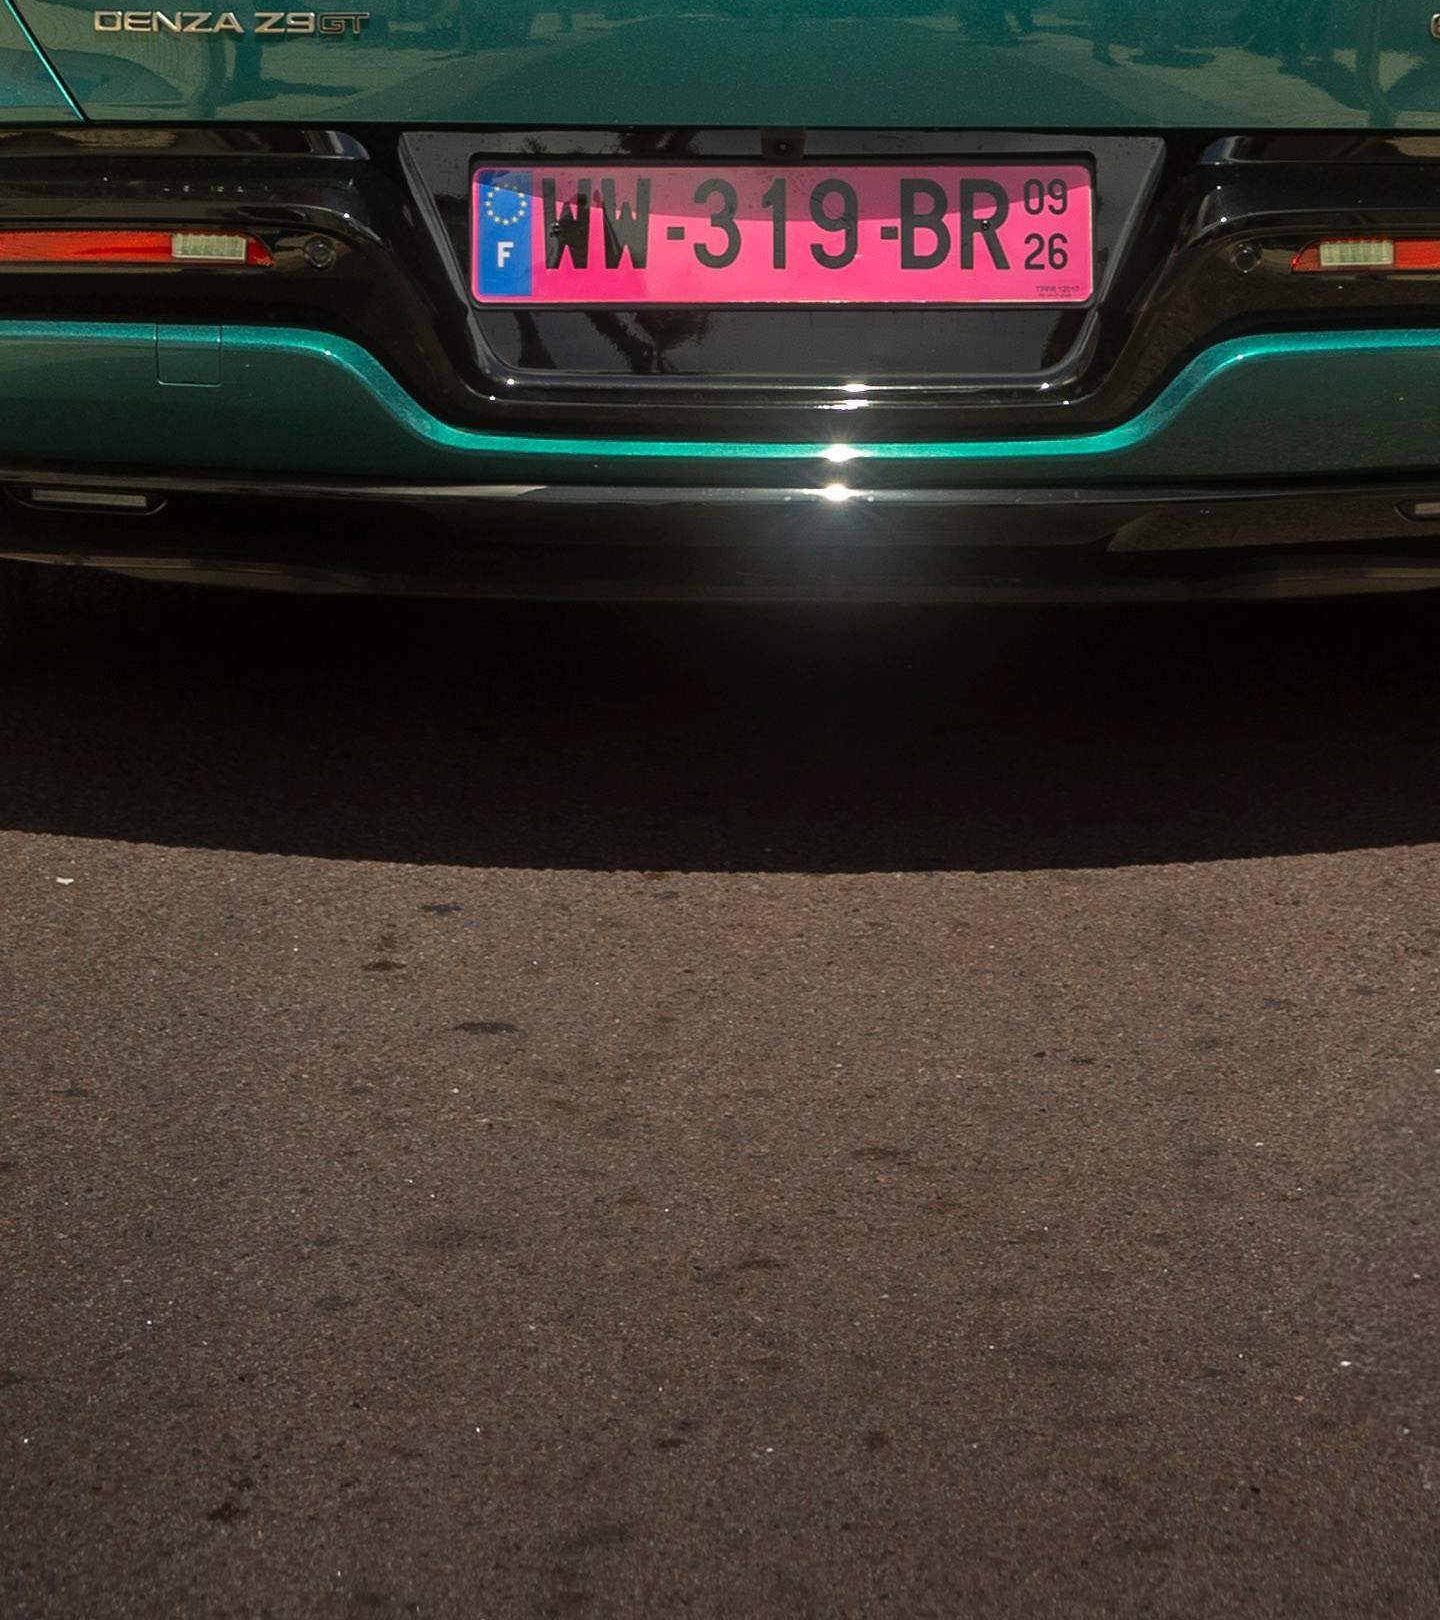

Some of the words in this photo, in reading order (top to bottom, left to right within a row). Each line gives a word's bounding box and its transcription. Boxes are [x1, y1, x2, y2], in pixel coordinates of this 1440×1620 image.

[94, 10, 244, 34] DENZA
[254, 10, 370, 35] Z9GT
[1024, 178, 1068, 216] 09
[541, 177, 1010, 270] WW-319-BR
[497, 241, 514, 268] F
[1024, 232, 1068, 270] 26
